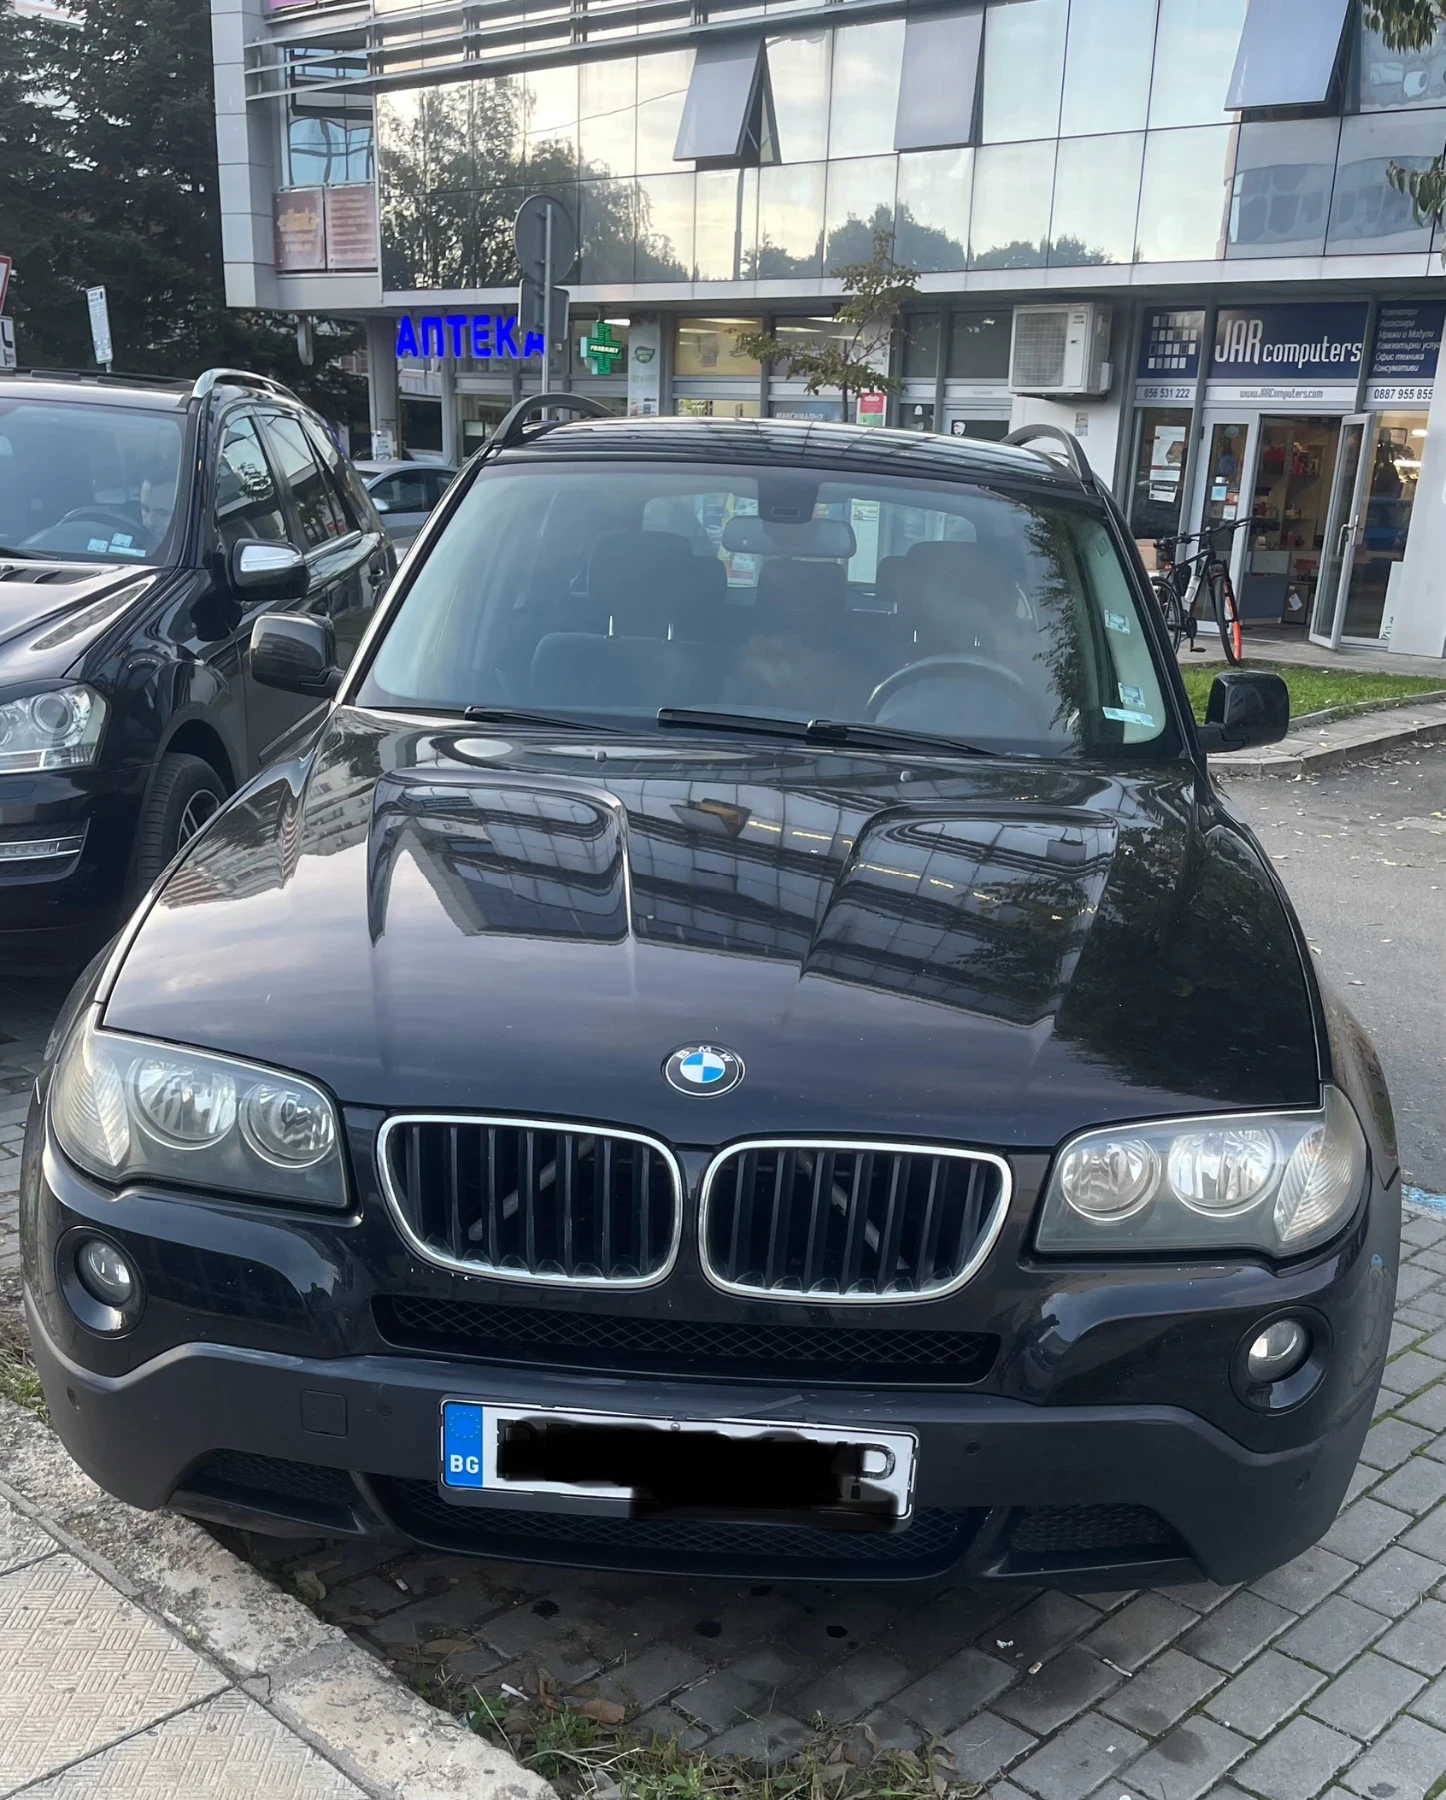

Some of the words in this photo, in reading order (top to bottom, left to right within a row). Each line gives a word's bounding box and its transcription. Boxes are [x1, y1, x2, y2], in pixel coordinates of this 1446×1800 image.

[1214, 319, 1263, 364] JAR
[1262, 335, 1362, 369] computers
[1376, 353, 1394, 362] Офис
[1373, 364, 1419, 373] Консумативи
[1144, 388, 1158, 398] 056
[1160, 388, 1174, 398] 531
[1175, 388, 1190, 398] 222
[1239, 387, 1324, 401] www.JARComputers.com
[1373, 388, 1396, 400] 0887
[1397, 388, 1415, 400] 955
[1416, 388, 1434, 400] 855
[675, 1045, 734, 1063] BMW
[450, 1453, 480, 1475] BG
